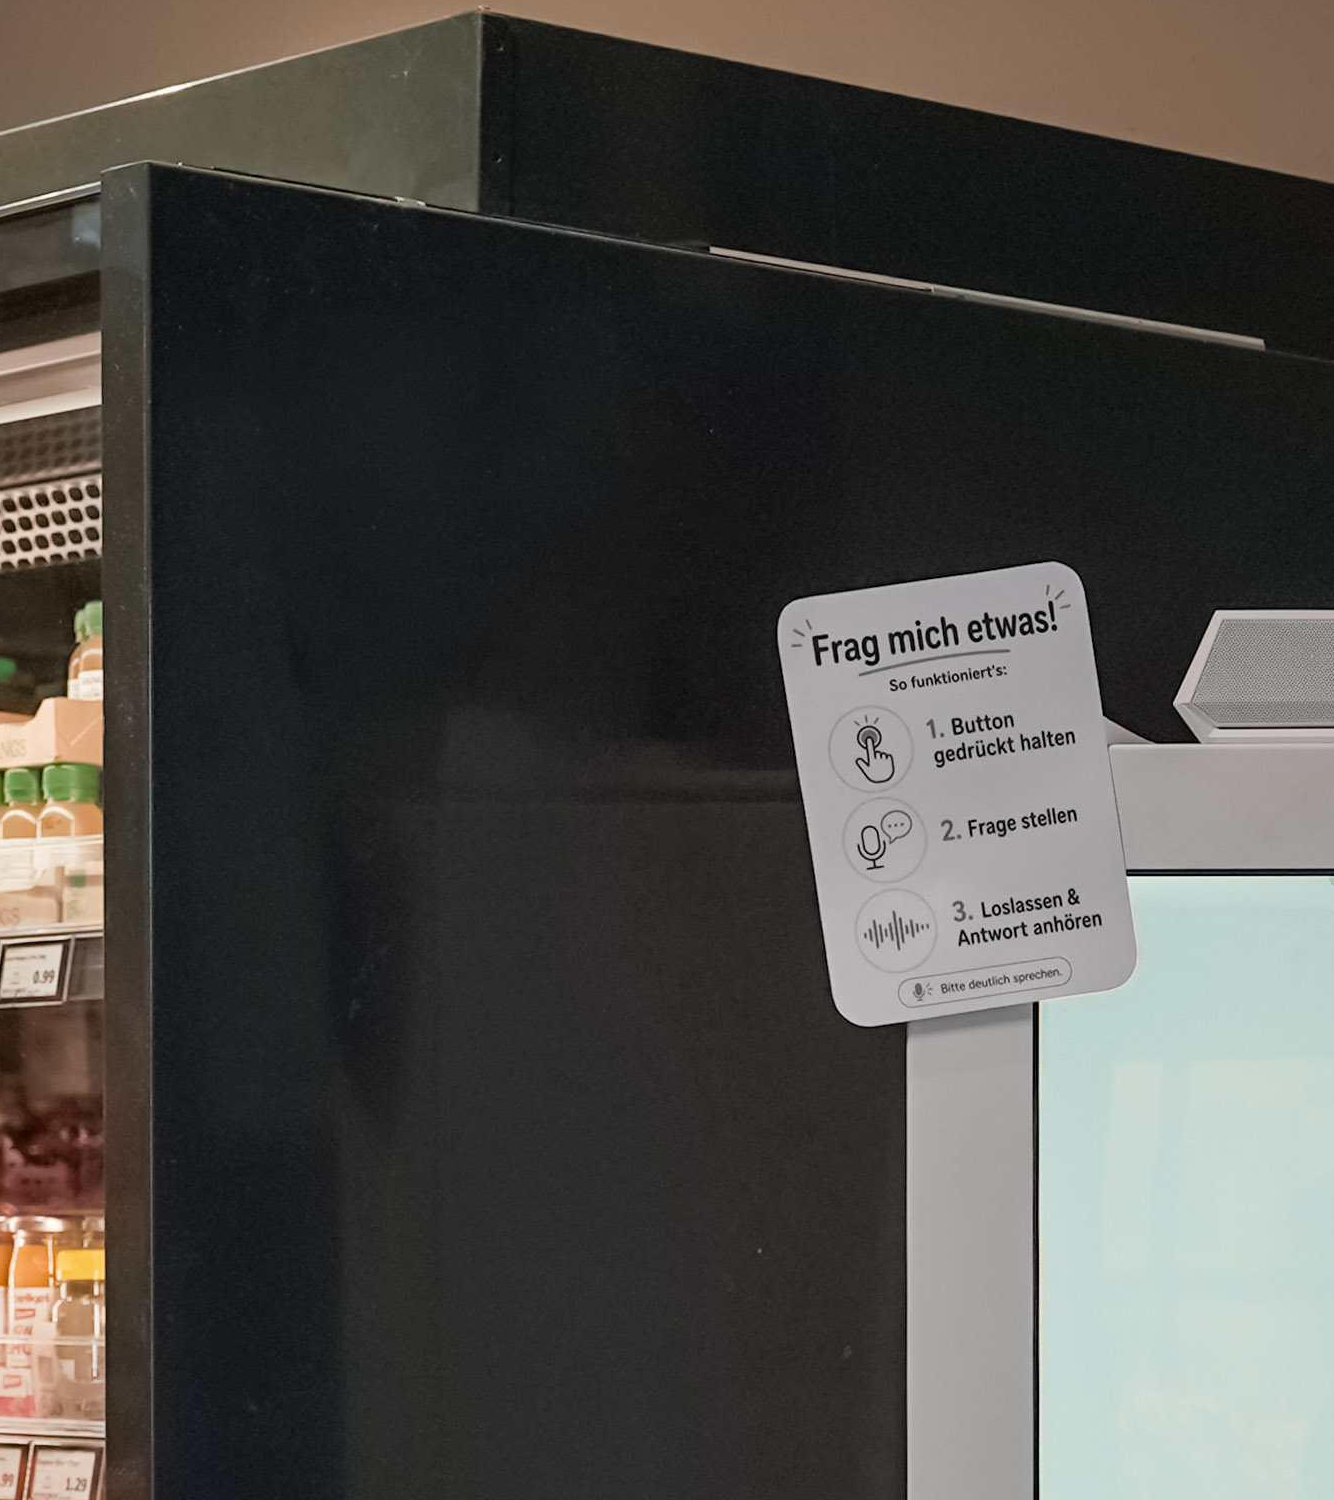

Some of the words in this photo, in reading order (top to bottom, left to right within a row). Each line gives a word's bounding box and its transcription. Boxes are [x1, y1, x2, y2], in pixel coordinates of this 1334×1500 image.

[812, 632, 881, 667] Frag
[888, 616, 960, 656] mich
[967, 600, 1059, 642] etwas!
[889, 678, 908, 692] So
[911, 664, 1008, 690] funktioniert's:
[925, 719, 946, 740] 1.
[951, 713, 1015, 737] Button
[933, 737, 1018, 768] gedrückt
[1020, 729, 1077, 752] halten
[940, 819, 962, 842] 2.
[967, 816, 1018, 841] Frage
[1021, 807, 1079, 830] stellen
[952, 900, 974, 923] 3.
[980, 893, 1064, 919] Loslassen
[1067, 887, 1081, 906] &
[957, 920, 1030, 948] Antwort
[1033, 910, 1103, 936] anhören
[941, 980, 965, 995] Bitte
[968, 974, 1011, 992] deutlich
[1013, 967, 1064, 988] sprechen.
